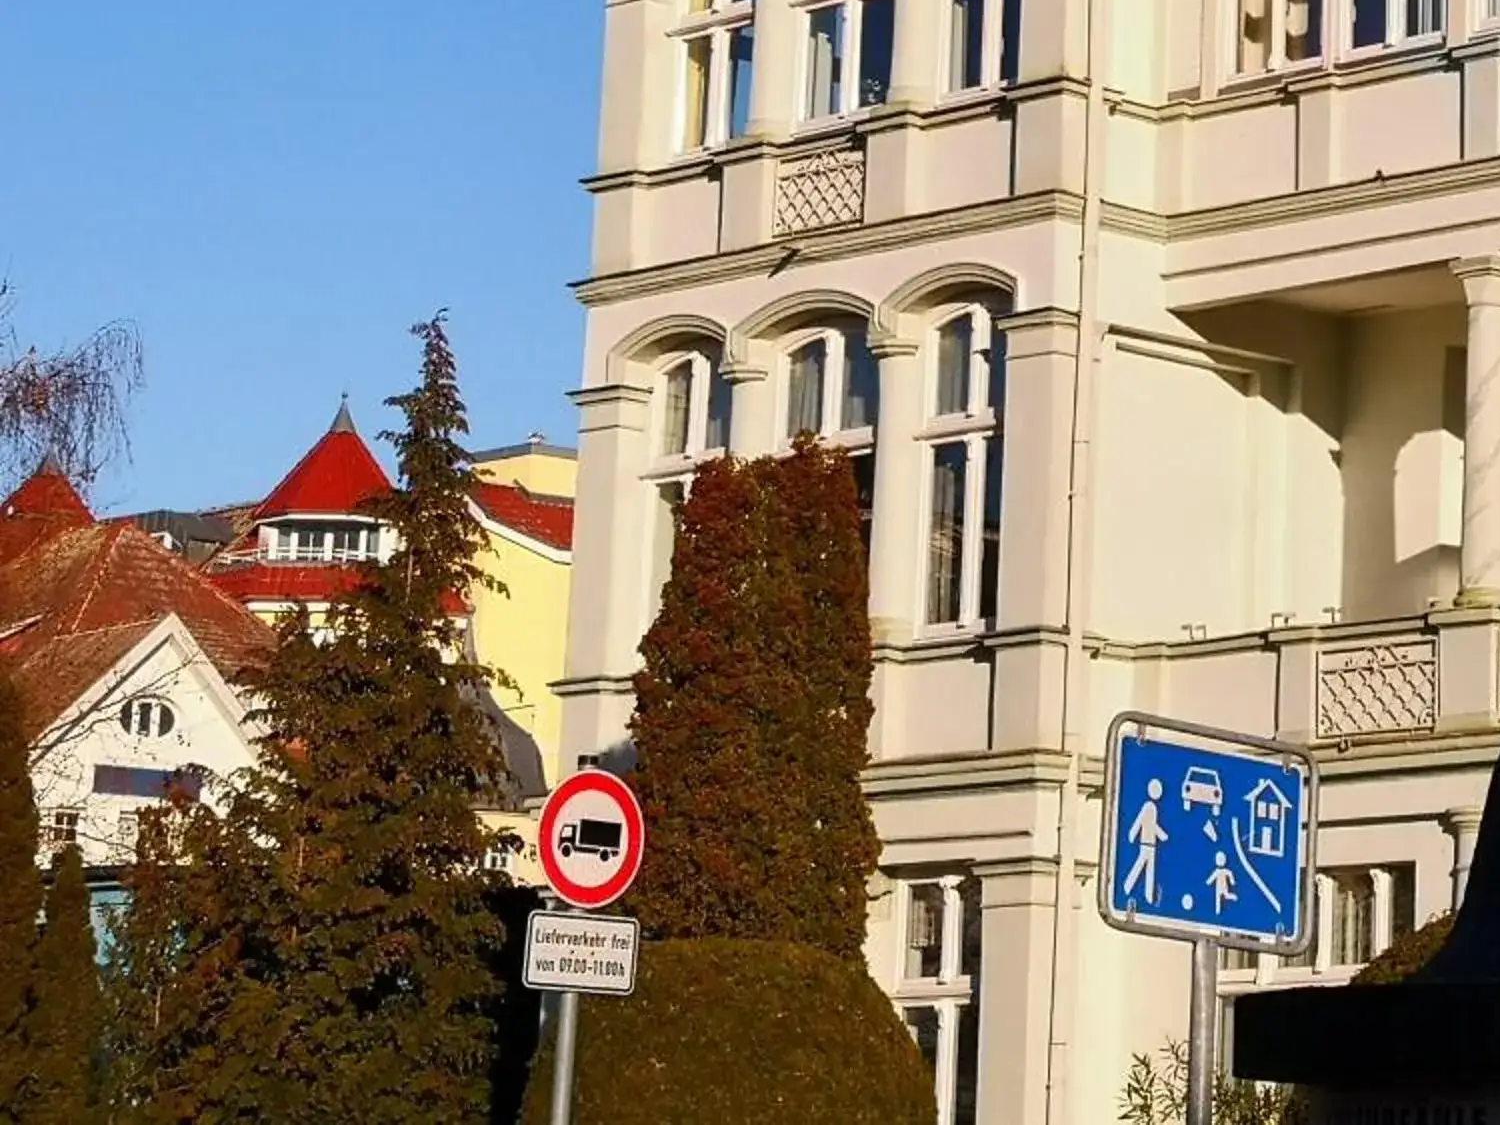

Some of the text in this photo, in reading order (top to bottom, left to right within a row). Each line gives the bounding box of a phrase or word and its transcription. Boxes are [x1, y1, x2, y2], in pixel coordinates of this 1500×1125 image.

[535, 928, 631, 949] Lieferverkehr frei
[535, 958, 555, 972] von
